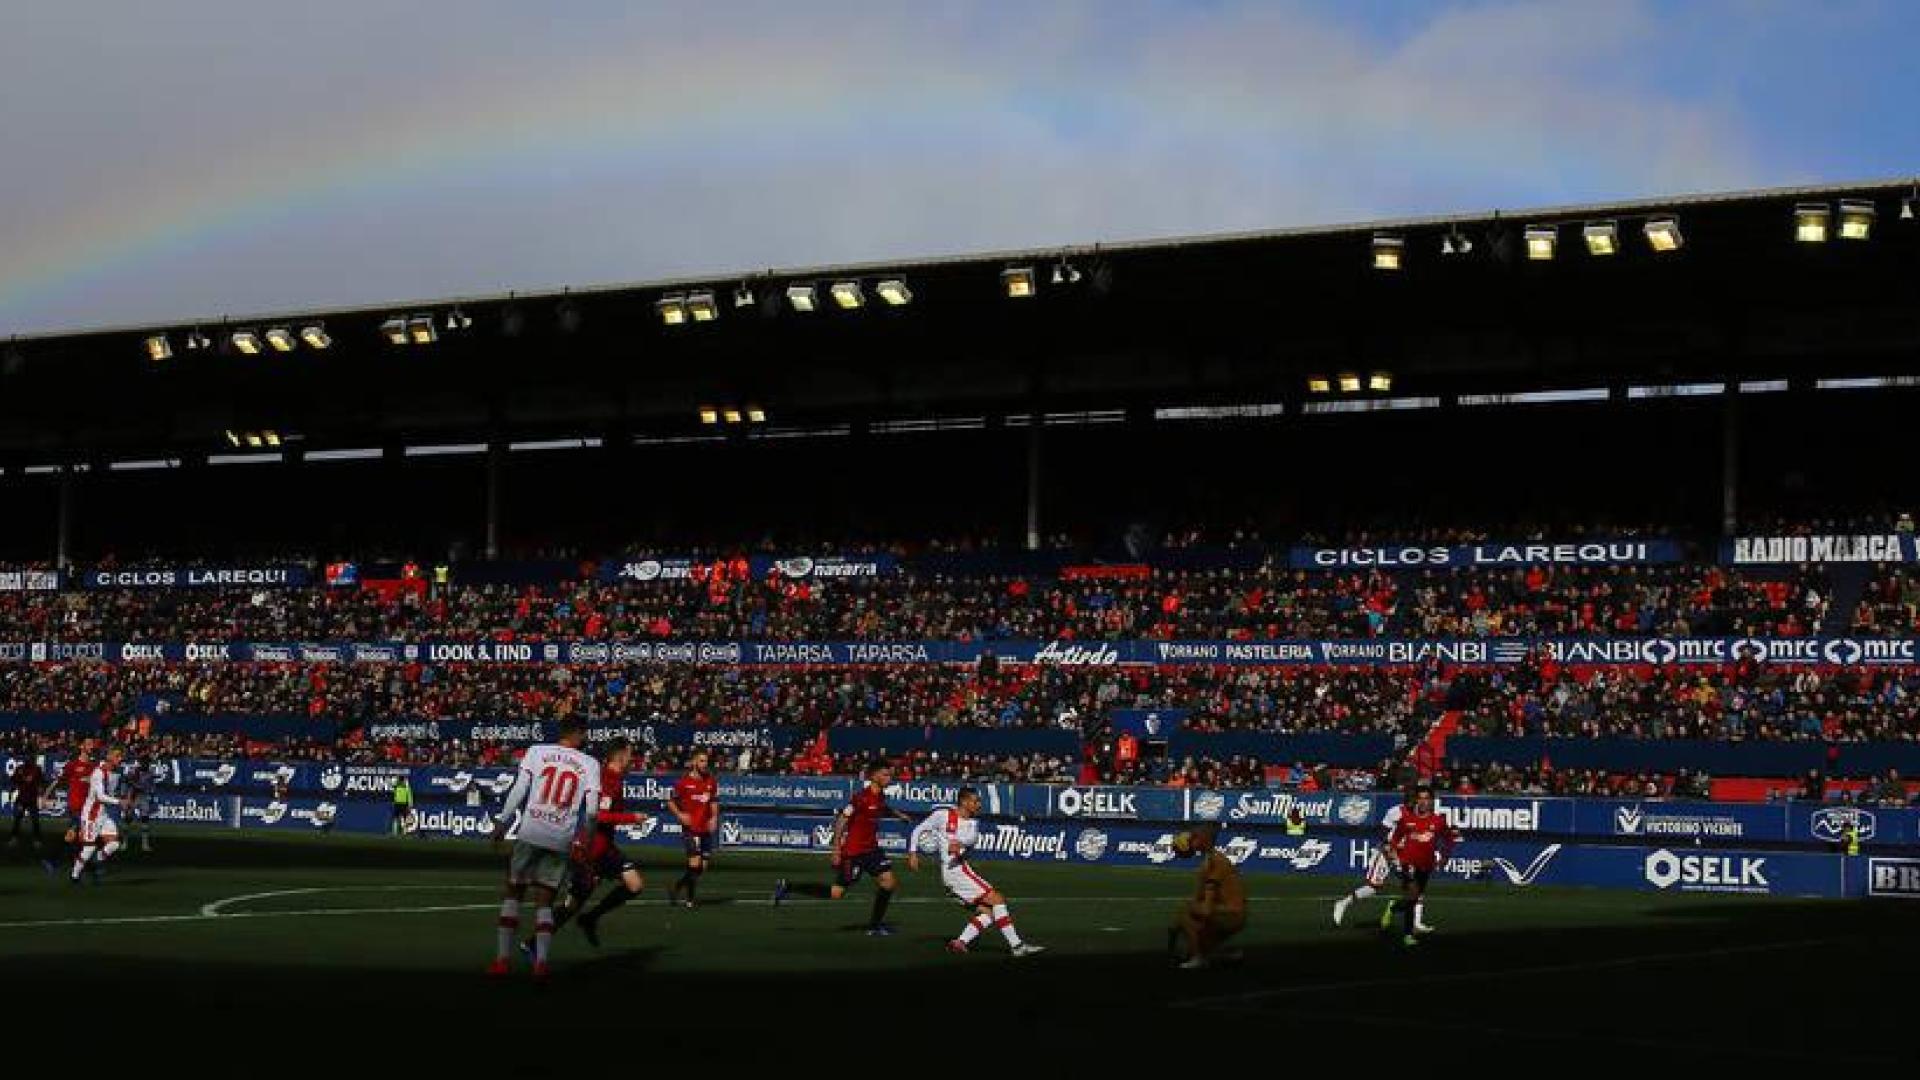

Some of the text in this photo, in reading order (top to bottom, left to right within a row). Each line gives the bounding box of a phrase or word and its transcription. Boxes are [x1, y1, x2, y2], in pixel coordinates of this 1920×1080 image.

[1314, 544, 1646, 565] CICLOS LAREQUI
[1733, 537, 1807, 563] RADIO
[1810, 535, 1902, 562] MARCA
[97, 570, 287, 585] CICLOS LAREQUI
[431, 644, 475, 660] LOOK
[494, 644, 532, 660] FIND
[756, 644, 833, 662] TAPARSA
[846, 644, 928, 662] TAPARSA
[1225, 644, 1313, 660] PASTELERIA
[1389, 642, 1487, 662] BIANBI
[1679, 640, 1725, 657] mrc
[1770, 640, 1818, 657] mrc
[1864, 640, 1915, 657] mrc
[541, 765, 579, 809] 10
[419, 810, 476, 836] LaLiga
[1433, 798, 1538, 831] hummel
[996, 824, 1068, 859] Miguel
